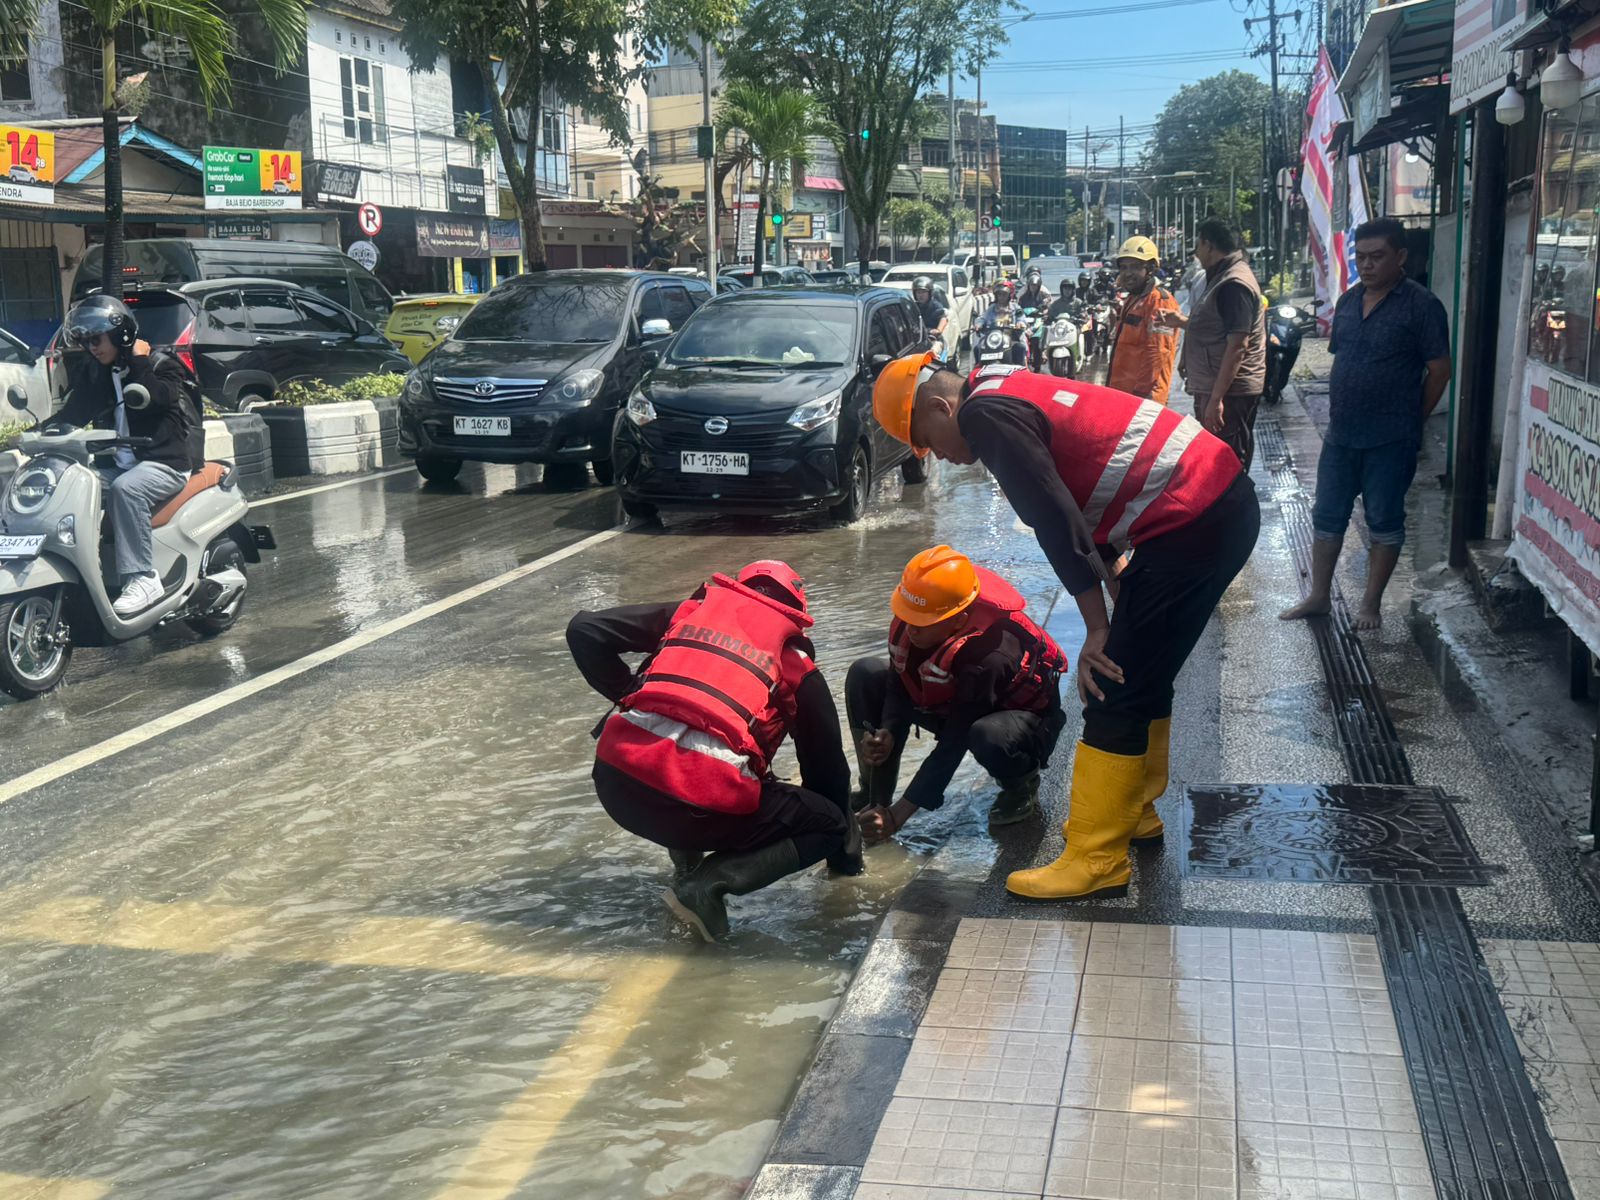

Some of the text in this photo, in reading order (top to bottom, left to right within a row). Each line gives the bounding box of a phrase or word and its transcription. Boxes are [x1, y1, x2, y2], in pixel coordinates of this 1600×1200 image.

[7, 131, 46, 171] 14 RB
[207, 151, 235, 163] GrabCar
[271, 154, 291, 184] 14
[324, 167, 357, 185] SALON
[226, 198, 285, 207] BAJA BEJO BARBERSHOP
[218, 225, 261, 233] BAJA BEJO
[456, 418, 509, 430] KT 1627 KB
[683, 453, 747, 468] KT 1756 HA
[0, 537, 42, 547] 2347 KX
[678, 624, 774, 673] BRIMOB
